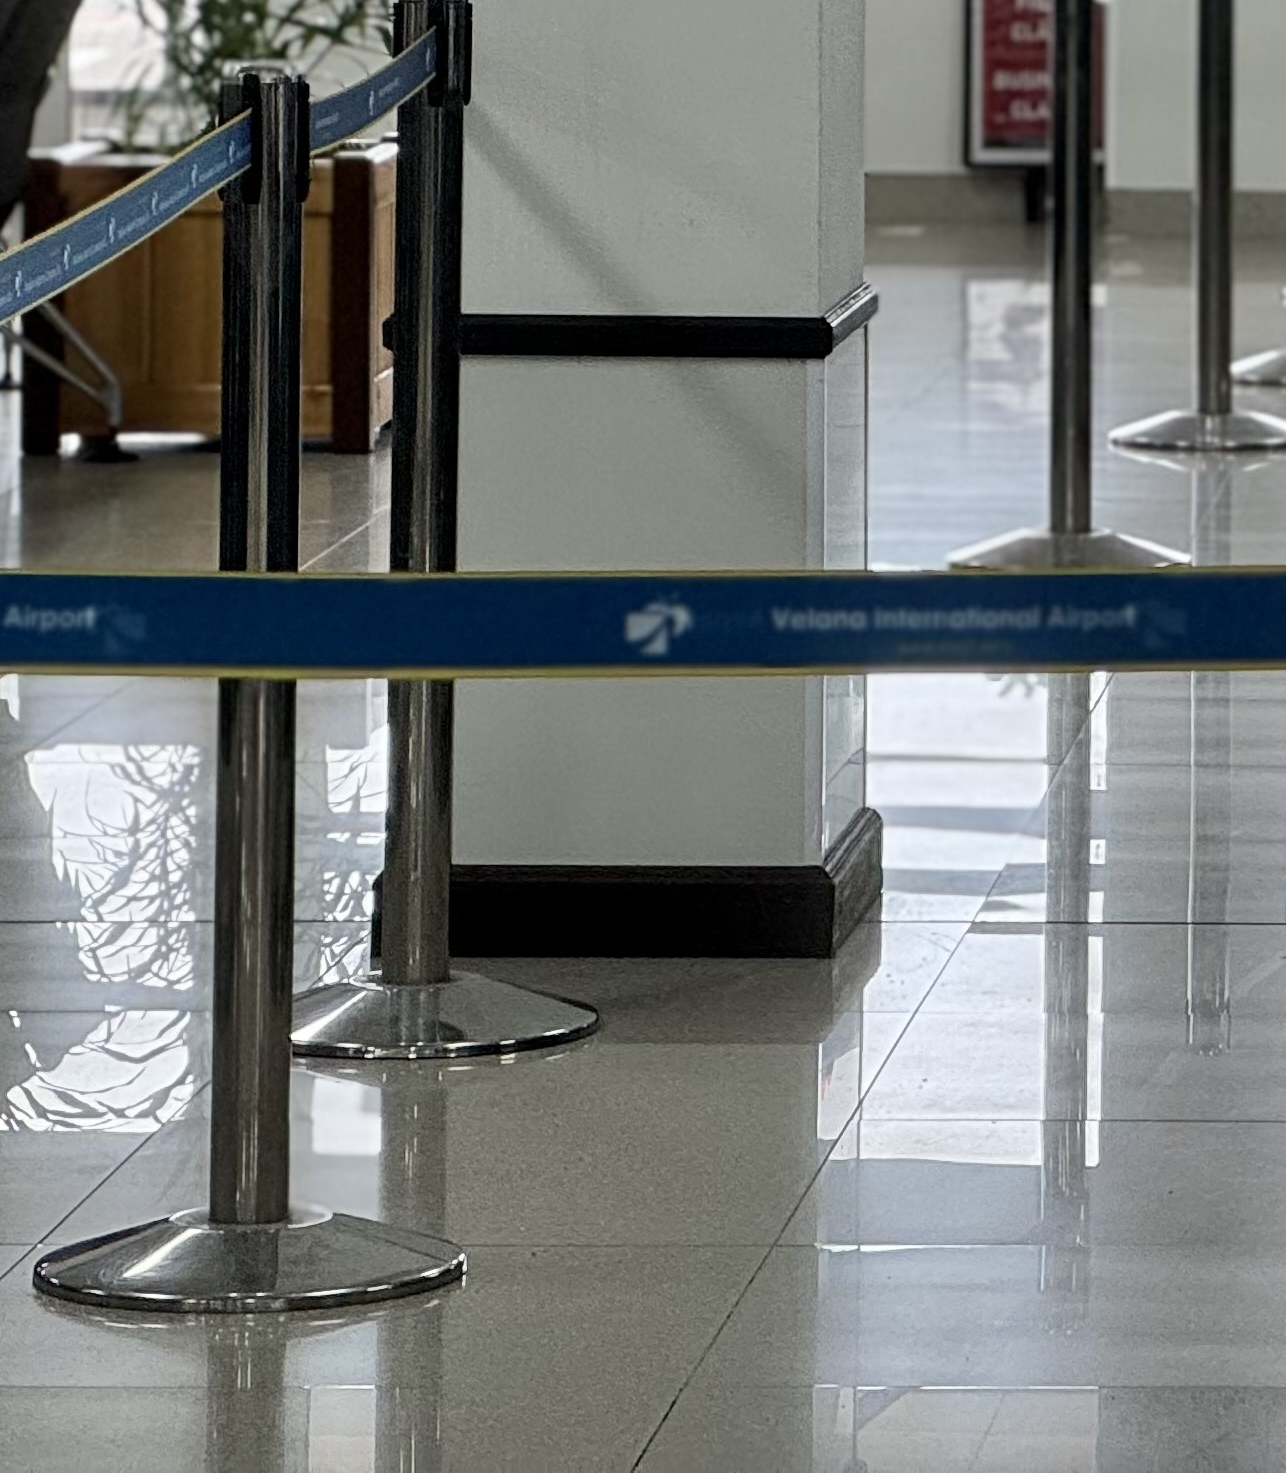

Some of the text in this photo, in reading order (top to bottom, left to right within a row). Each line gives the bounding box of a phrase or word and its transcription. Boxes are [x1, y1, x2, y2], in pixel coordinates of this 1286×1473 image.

[1009, 22, 1050, 43] CLA
[1008, 100, 1050, 121] CLA
[3, 603, 97, 633] Airport
[770, 603, 1137, 634] Velana International Airport
